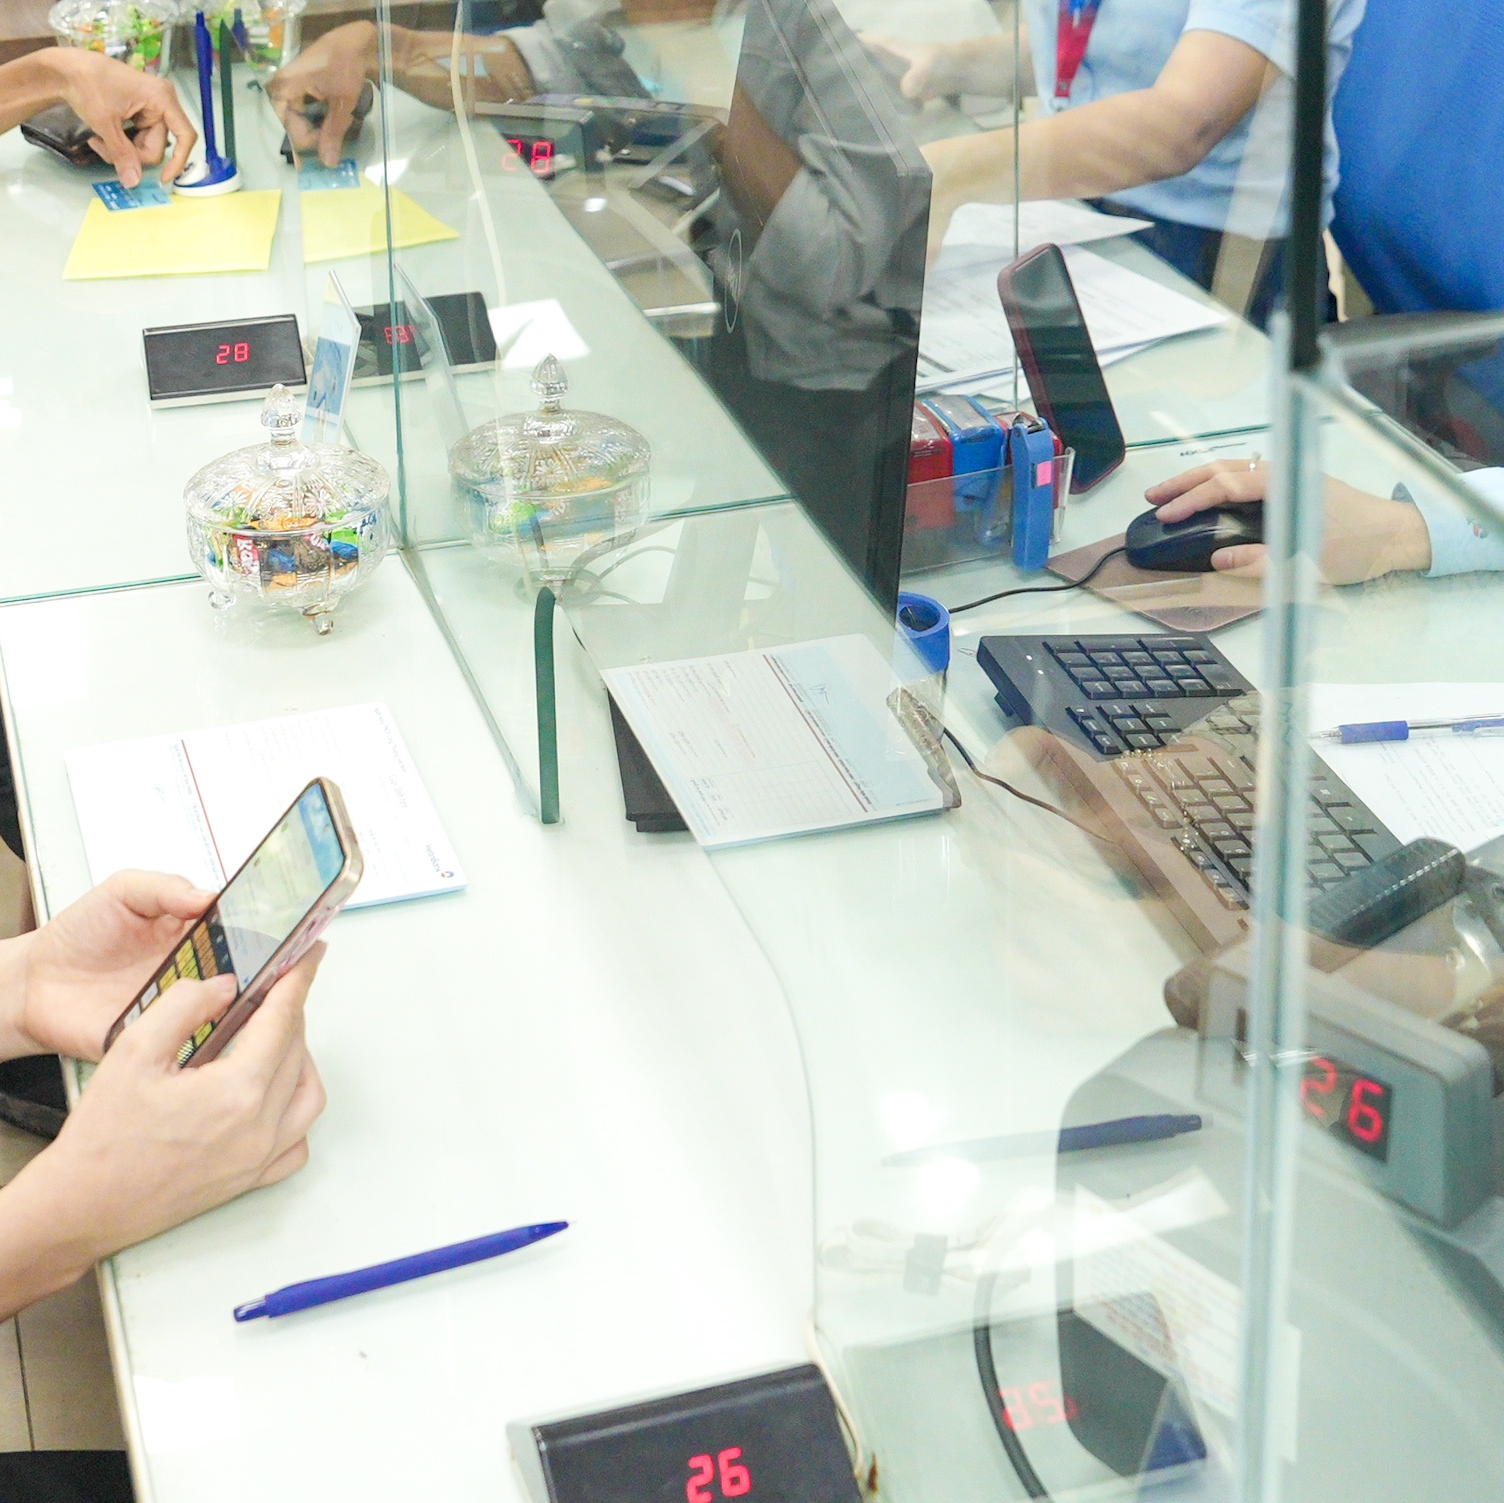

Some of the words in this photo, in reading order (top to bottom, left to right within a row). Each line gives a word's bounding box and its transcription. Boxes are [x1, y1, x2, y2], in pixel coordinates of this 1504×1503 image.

[216, 342, 250, 365] 28
[1298, 1055, 1384, 1143] 26
[686, 1447, 752, 1503] 26
